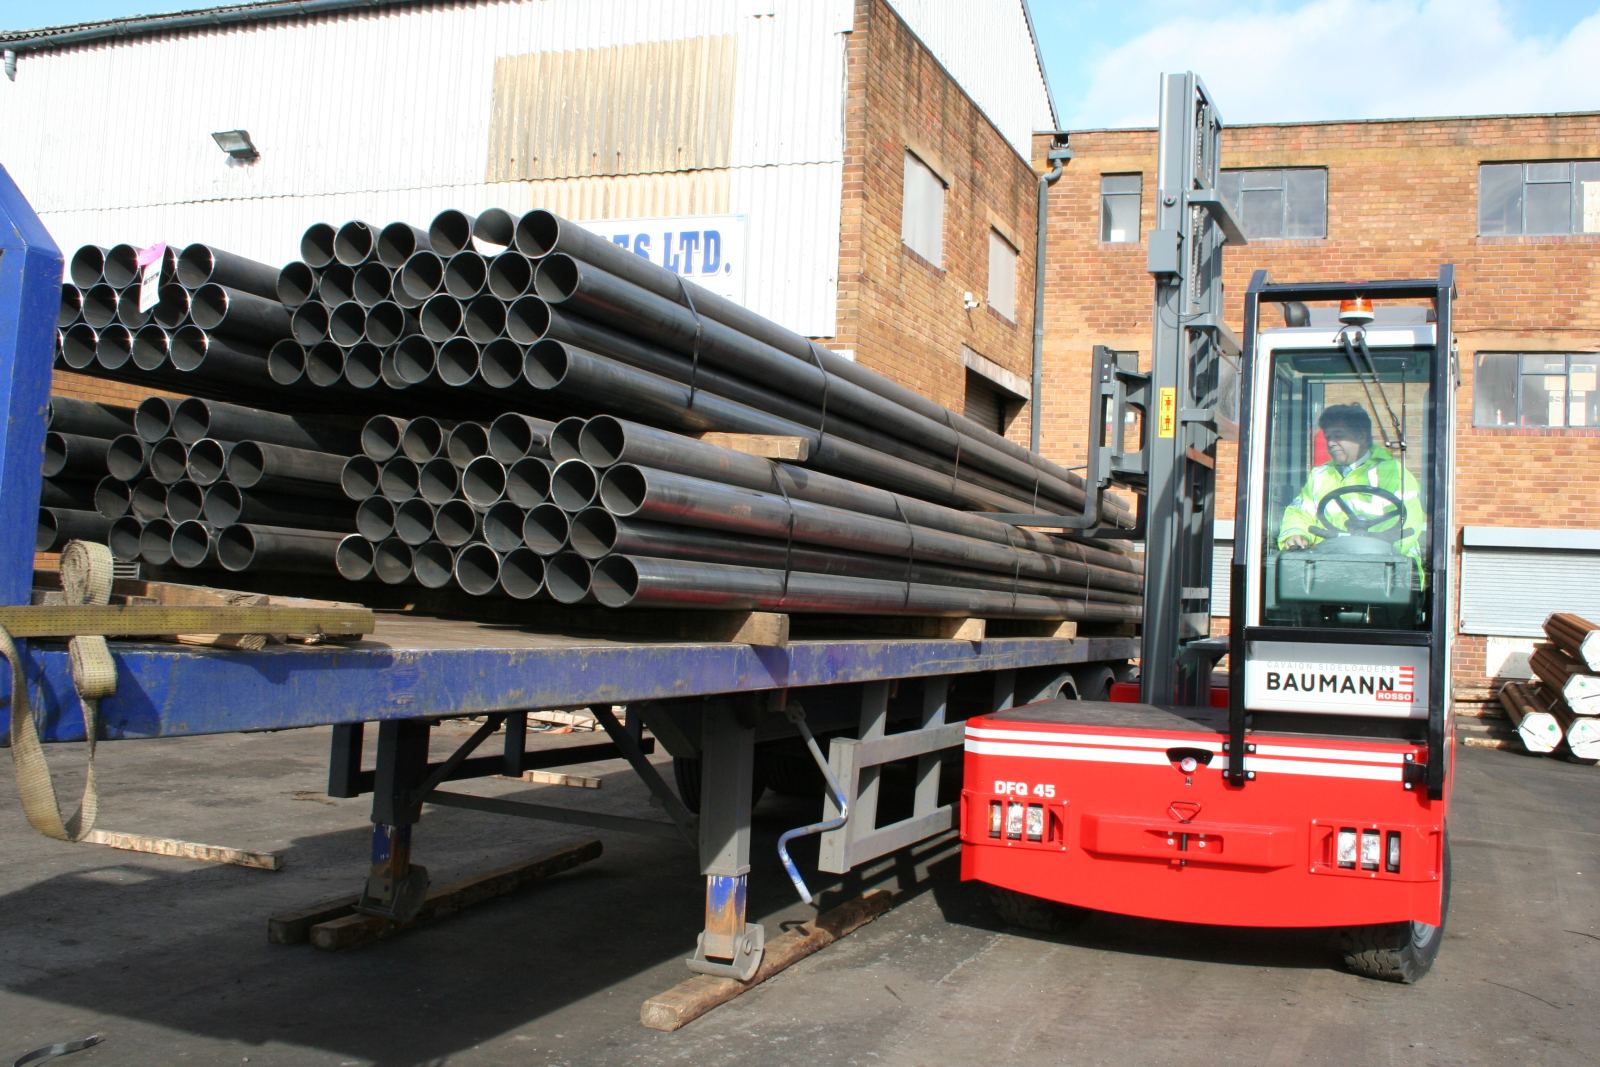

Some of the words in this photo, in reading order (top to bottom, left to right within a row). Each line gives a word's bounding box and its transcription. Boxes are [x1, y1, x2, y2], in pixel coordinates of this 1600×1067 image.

[663, 230, 731, 273] LTD.
[1318, 662, 1395, 673] SIDELOADERS
[1266, 672, 1394, 694] BAUMANN
[1377, 691, 1412, 701] ROSSO
[1033, 783, 1056, 798] 45
